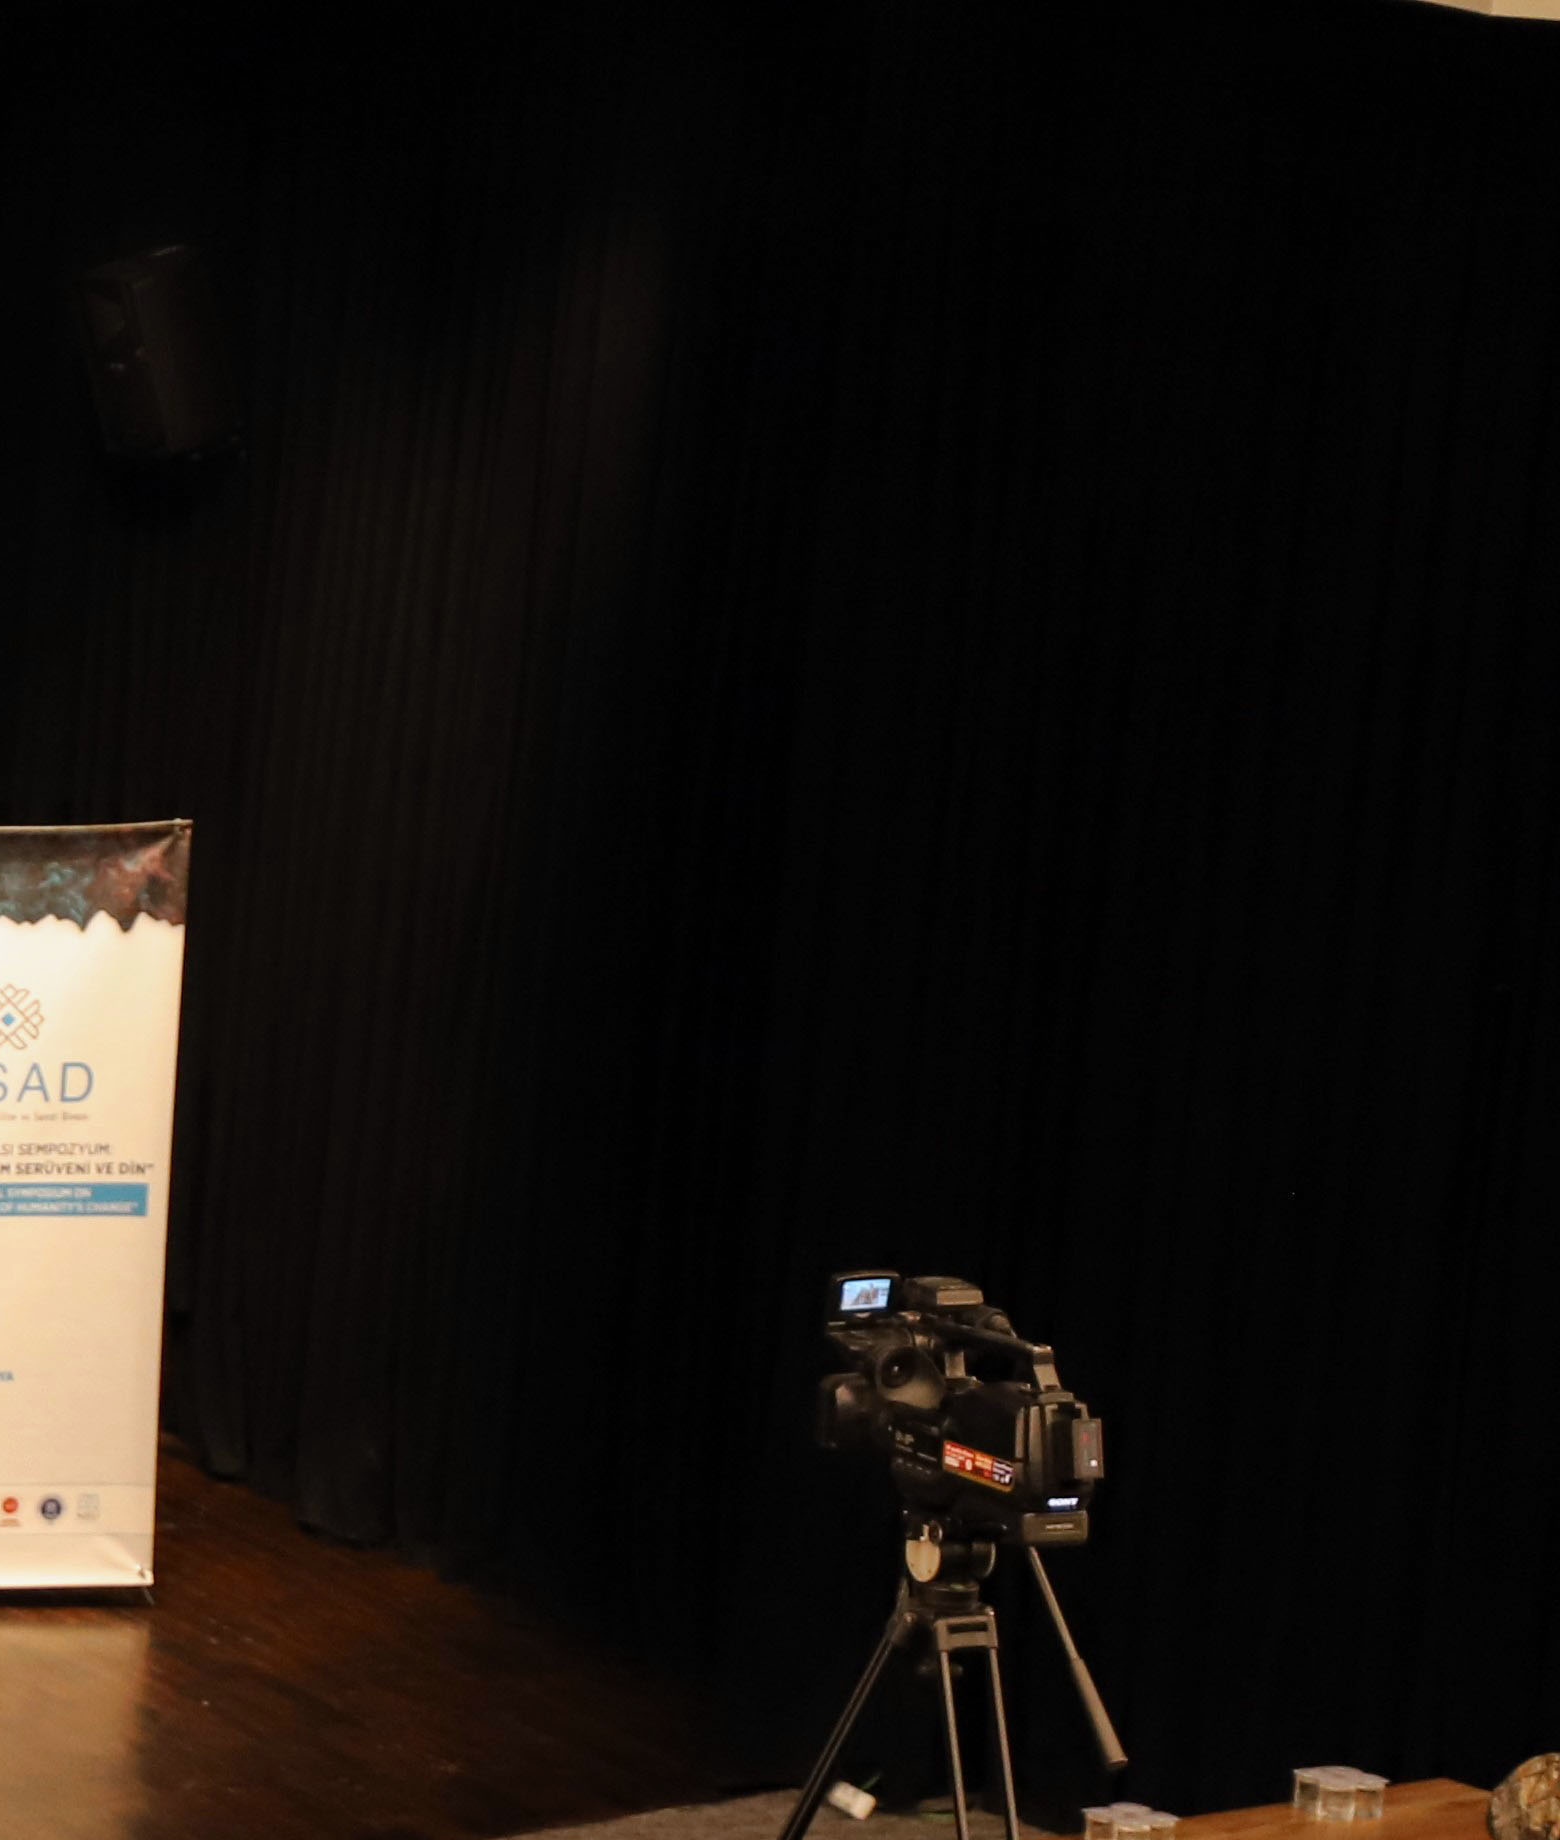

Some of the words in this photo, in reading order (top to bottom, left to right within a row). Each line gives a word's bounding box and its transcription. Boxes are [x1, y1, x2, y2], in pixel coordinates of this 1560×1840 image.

[16, 1160, 91, 1175] SERÜVENİ
[96, 1162, 114, 1174] VE
[1047, 1498, 1079, 1507] SONY
